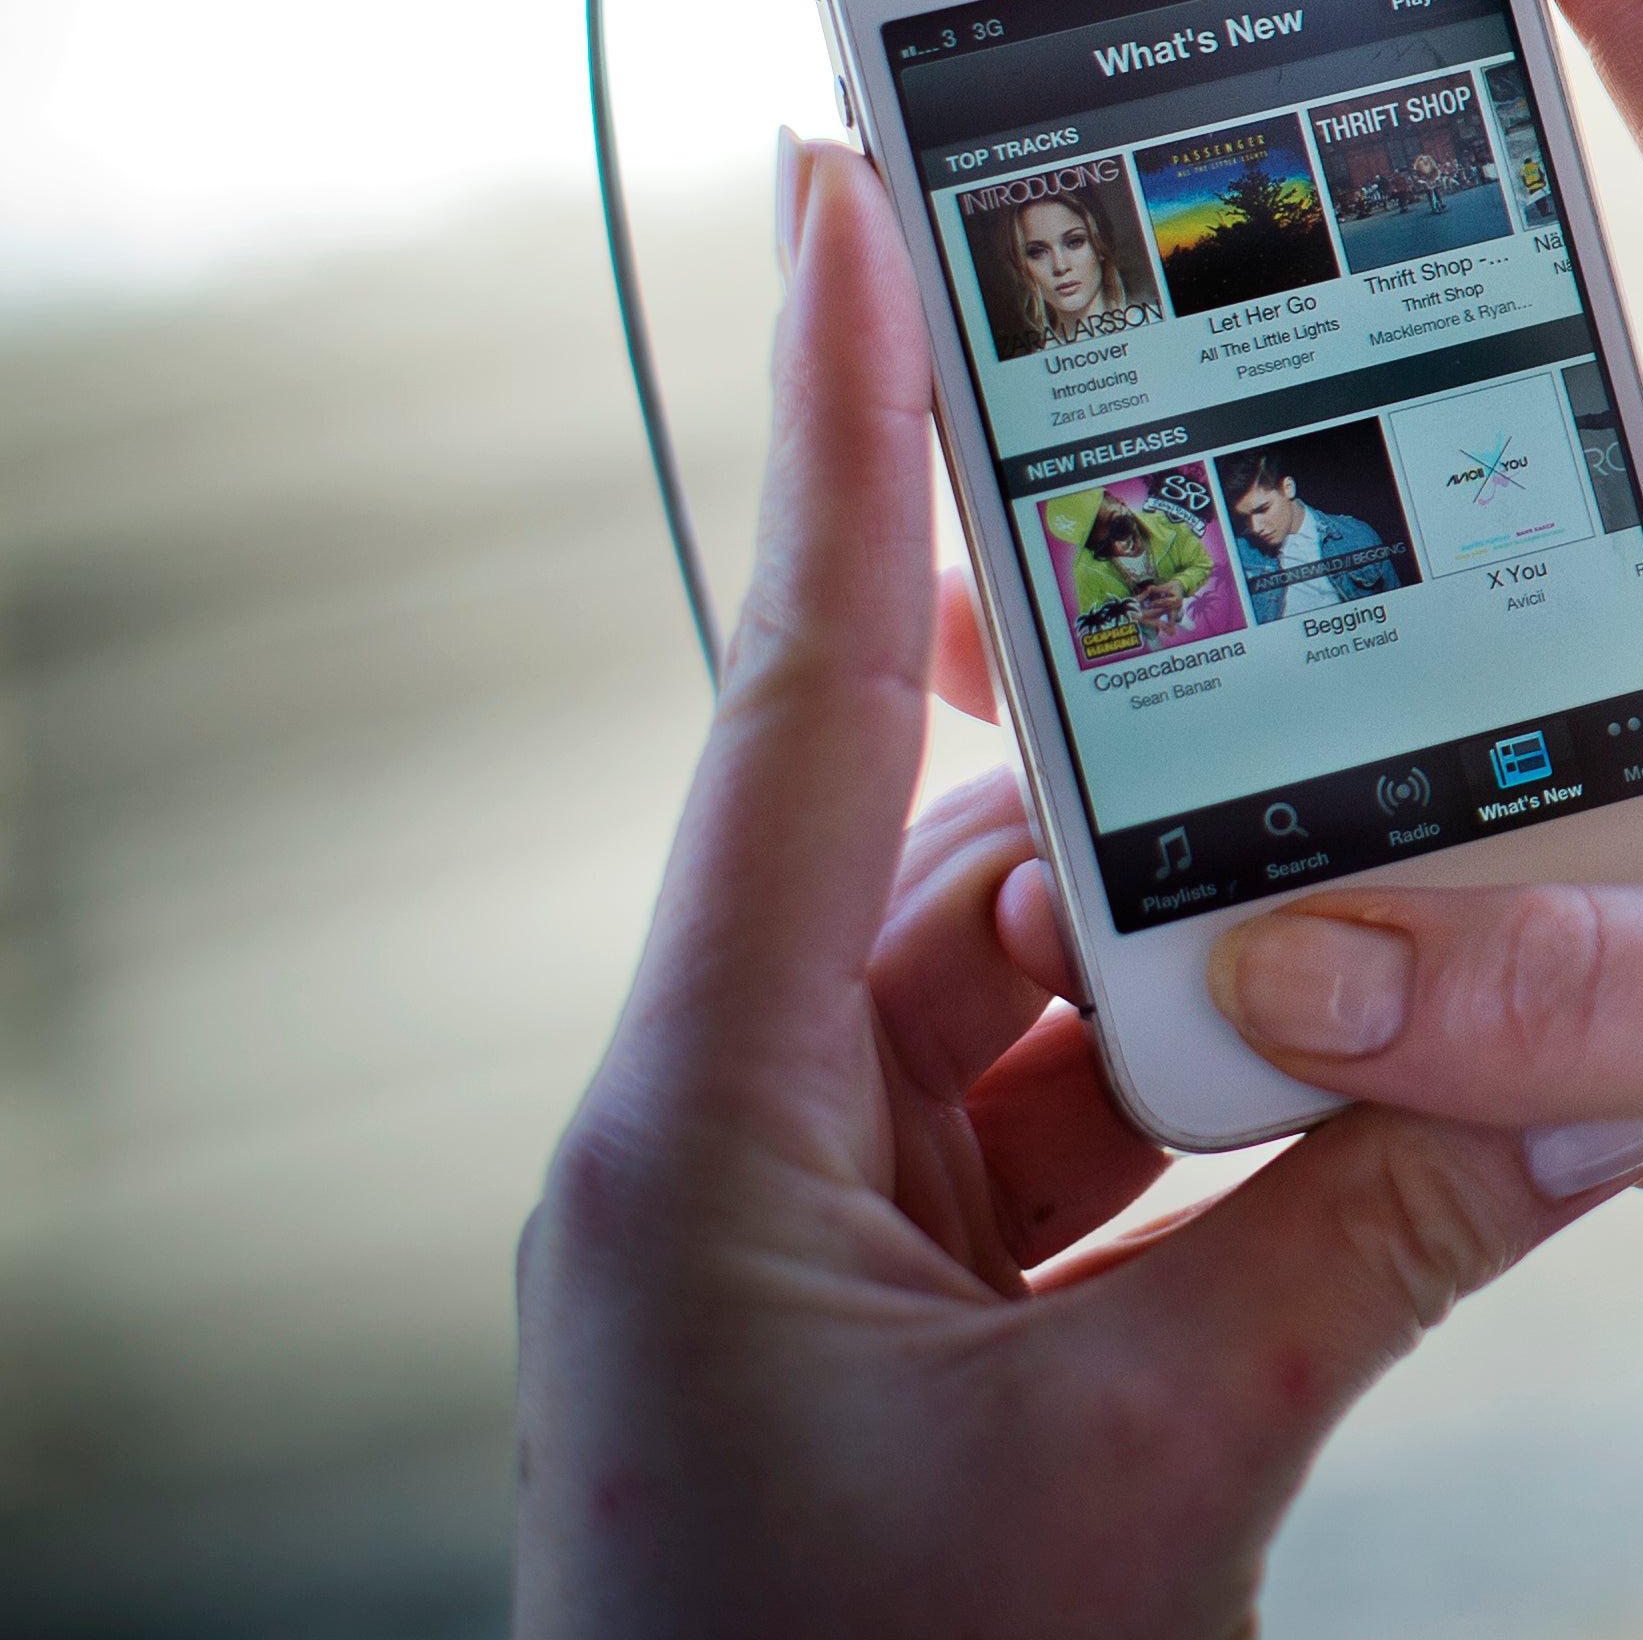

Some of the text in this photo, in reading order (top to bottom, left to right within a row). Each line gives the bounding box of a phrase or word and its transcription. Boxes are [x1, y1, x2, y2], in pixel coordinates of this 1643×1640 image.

[941, 18, 1005, 50] 3 3G
[1093, 8, 1304, 77] What's New
[1315, 85, 1473, 144] THRIFT SHOP
[945, 127, 1080, 173] TOP TRACKS
[1171, 134, 1266, 164] PASSENGER
[963, 159, 1120, 216] INTRODUCING
[1364, 268, 1417, 296] Thrift
[1420, 254, 1473, 282] Shop
[1208, 295, 1317, 335] Let Her Go
[1402, 283, 1485, 313] Thrift Shop
[1061, 299, 1164, 345] LARSSON
[1370, 299, 1533, 347] Macklemore & Ryan...
[1045, 339, 1130, 375] Uncover
[1200, 317, 1341, 364] All The Little Lights
[1236, 349, 1316, 380] Passenger
[1052, 369, 1138, 400] Introducing
[1052, 391, 1150, 427] Zara Larsson
[1026, 425, 1189, 481] NEW RELEASES
[1501, 456, 1528, 472] YOU
[1254, 569, 1301, 591] ANTON
[1302, 559, 1343, 579] EWALD
[1353, 542, 1407, 565] BEGGING
[1488, 562, 1548, 590] X You
[1506, 589, 1547, 611] Avicii
[1303, 604, 1387, 638] Begging
[1306, 628, 1399, 664] Anton Ewald
[1093, 640, 1247, 693] Copacabanana
[1130, 675, 1223, 710] Sean Banan
[1478, 782, 1583, 822] What's New
[1389, 821, 1441, 847] Radio
[1266, 850, 1330, 880] Search
[1143, 880, 1217, 913] Playlists
